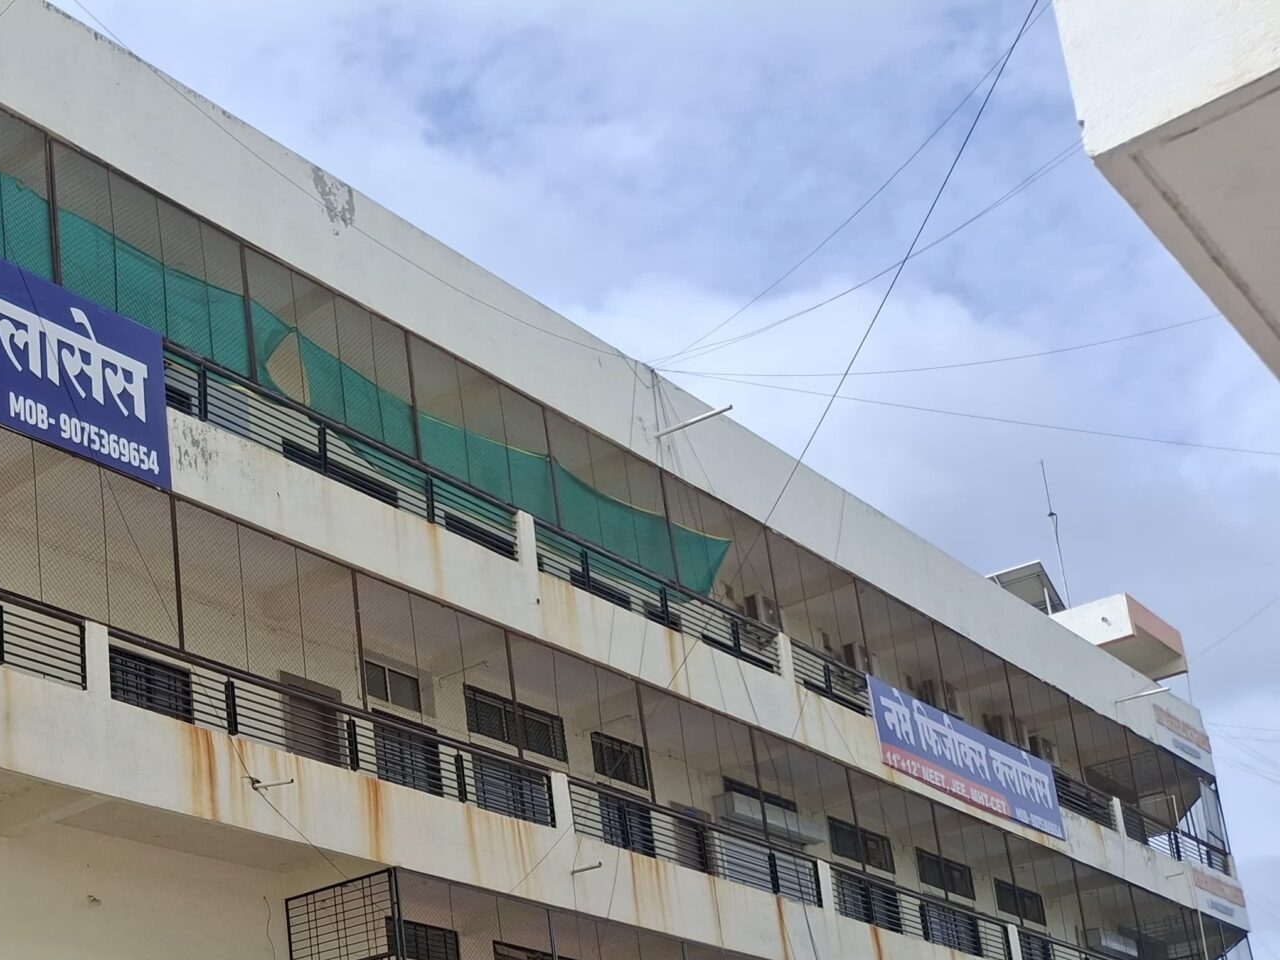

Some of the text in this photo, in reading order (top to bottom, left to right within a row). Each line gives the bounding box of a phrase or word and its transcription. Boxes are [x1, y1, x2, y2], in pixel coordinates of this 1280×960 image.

[9, 391, 160, 475] MOB- 9075369654
[912, 698, 992, 782] फिजीक्स
[989, 749, 1054, 810] क्लासेस
[970, 787, 1007, 814] MHT-CET
